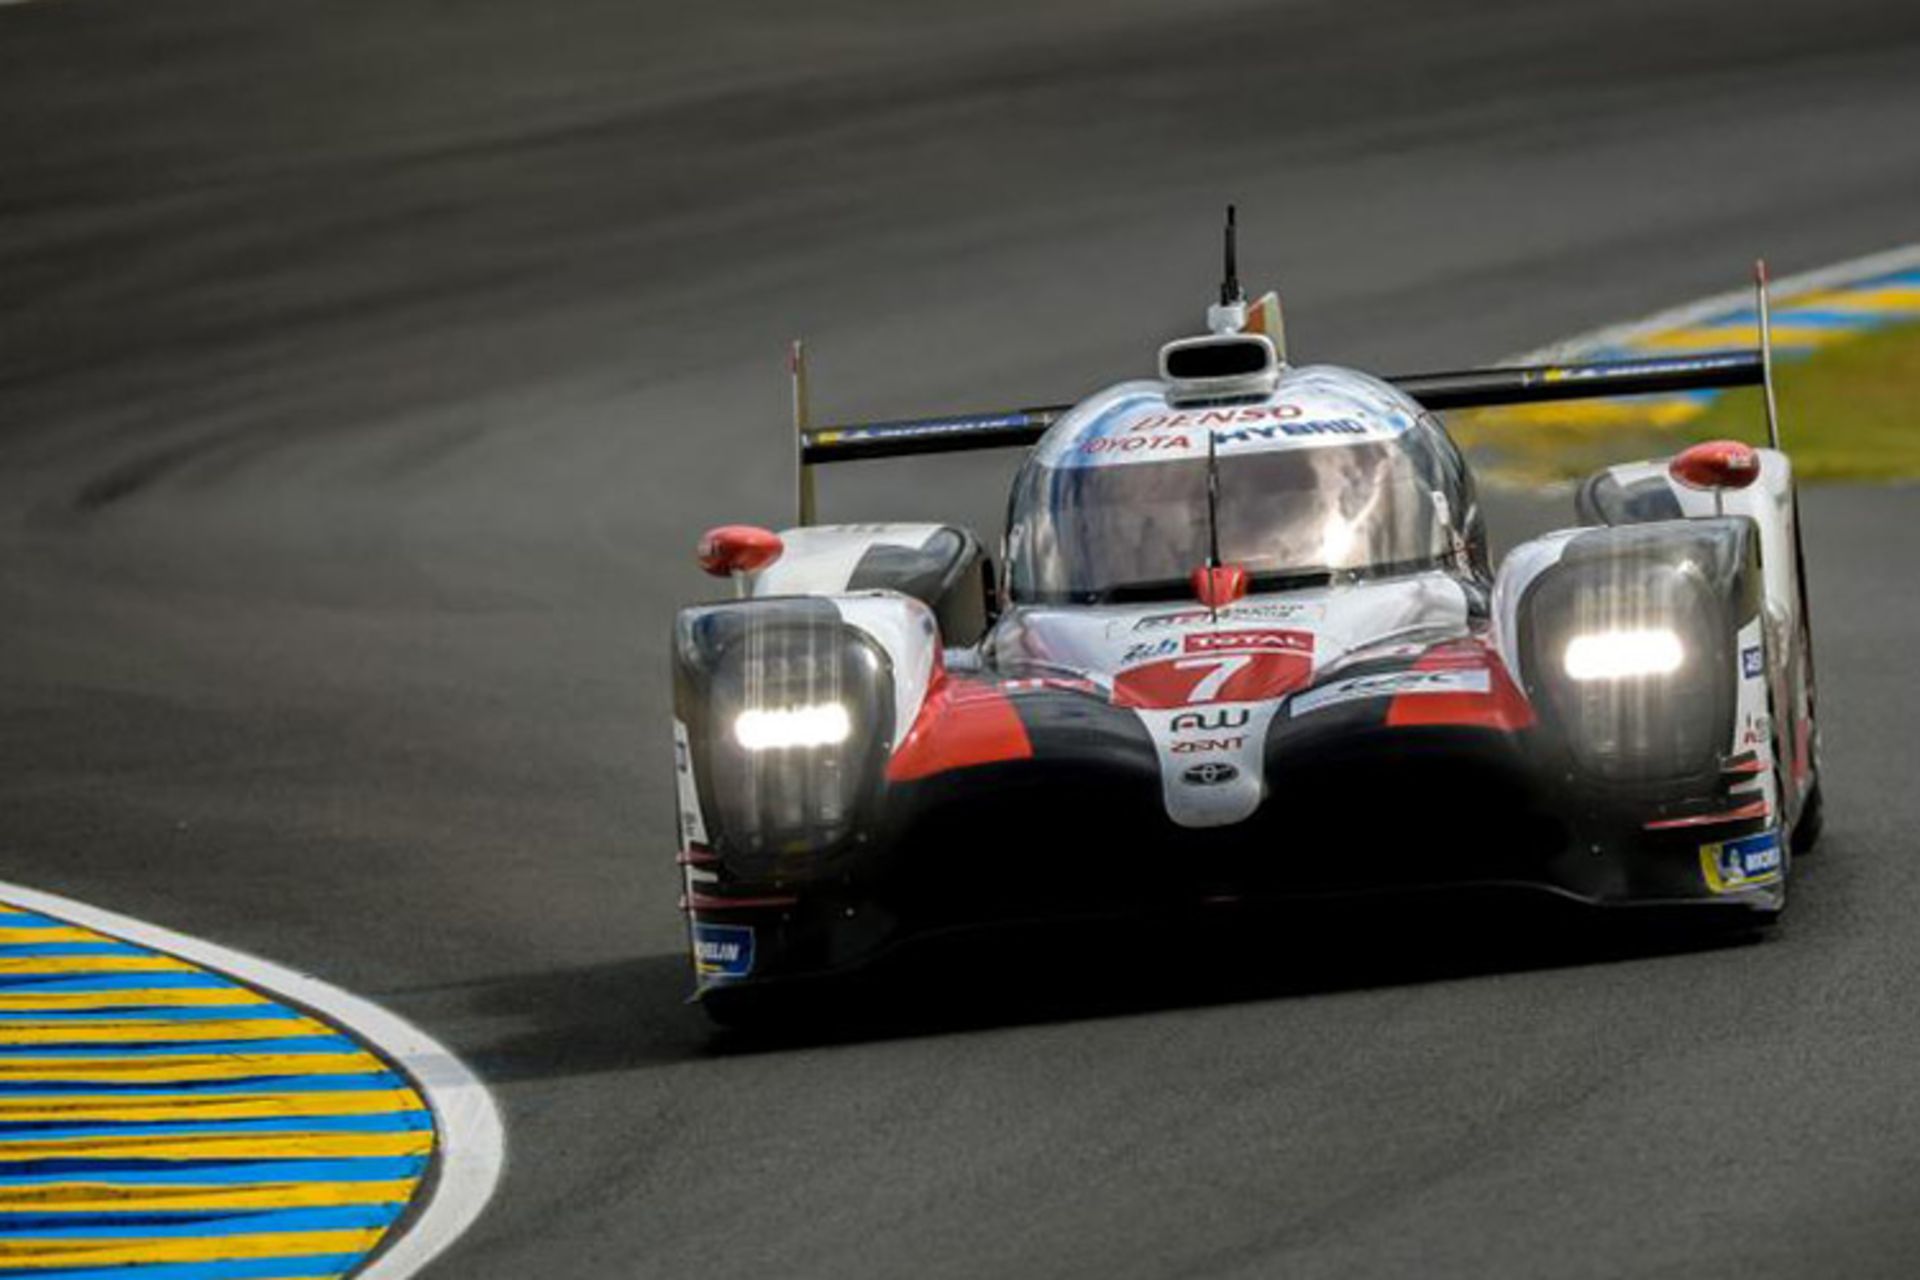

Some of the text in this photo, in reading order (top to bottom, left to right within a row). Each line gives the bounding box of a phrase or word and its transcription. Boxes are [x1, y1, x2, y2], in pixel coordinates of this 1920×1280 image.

[1131, 403, 1303, 431] DENSO
[1214, 418, 1367, 444] HYBRID
[1189, 634, 1308, 651] TOTAL
[1173, 654, 1251, 703] 7
[1170, 736, 1250, 753] ZENT
